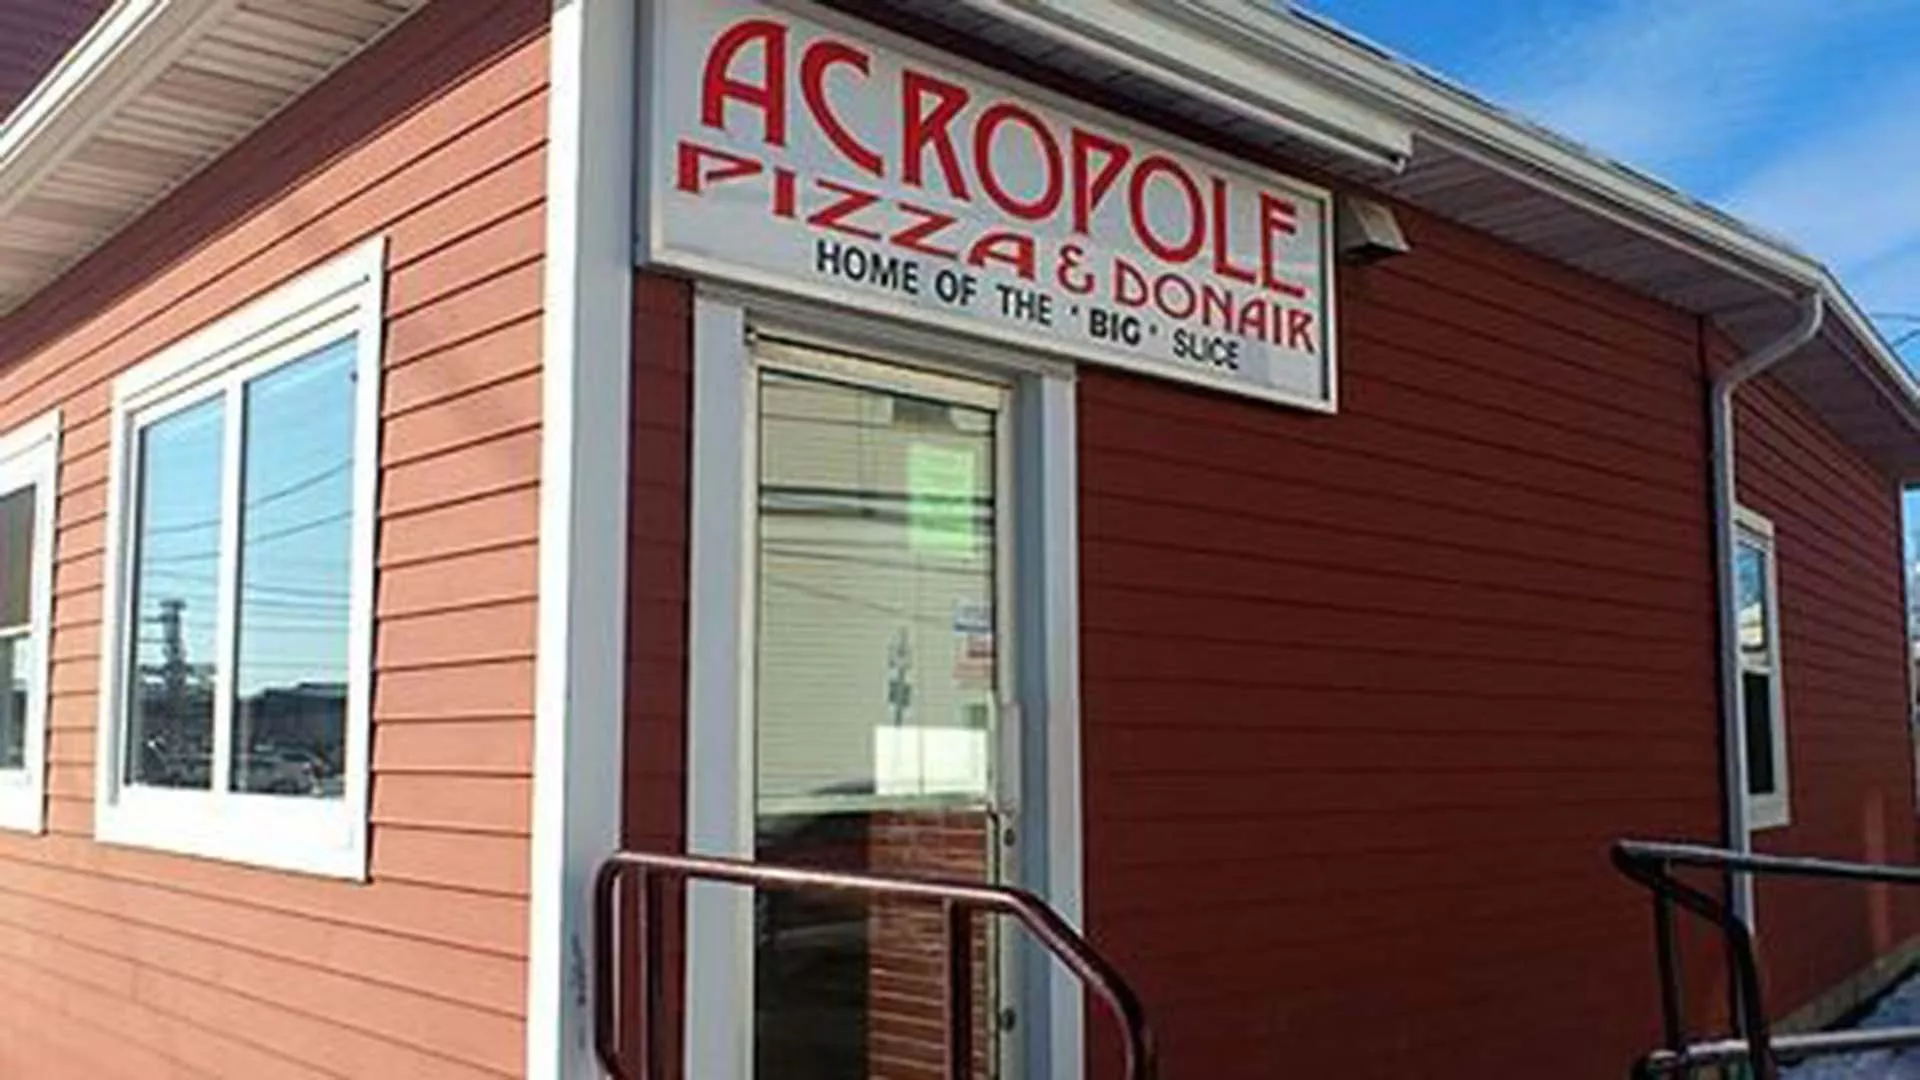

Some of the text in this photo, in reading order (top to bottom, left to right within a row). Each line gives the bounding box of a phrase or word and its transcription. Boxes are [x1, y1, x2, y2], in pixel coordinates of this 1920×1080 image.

[677, 140, 1315, 353] PIZZA & DONAIR
[701, 19, 1305, 298] ACROPOLE
[816, 239, 919, 294] HOME
[935, 268, 977, 305] OF
[997, 284, 1052, 326] THE
[1173, 328, 1239, 370] SLICE
